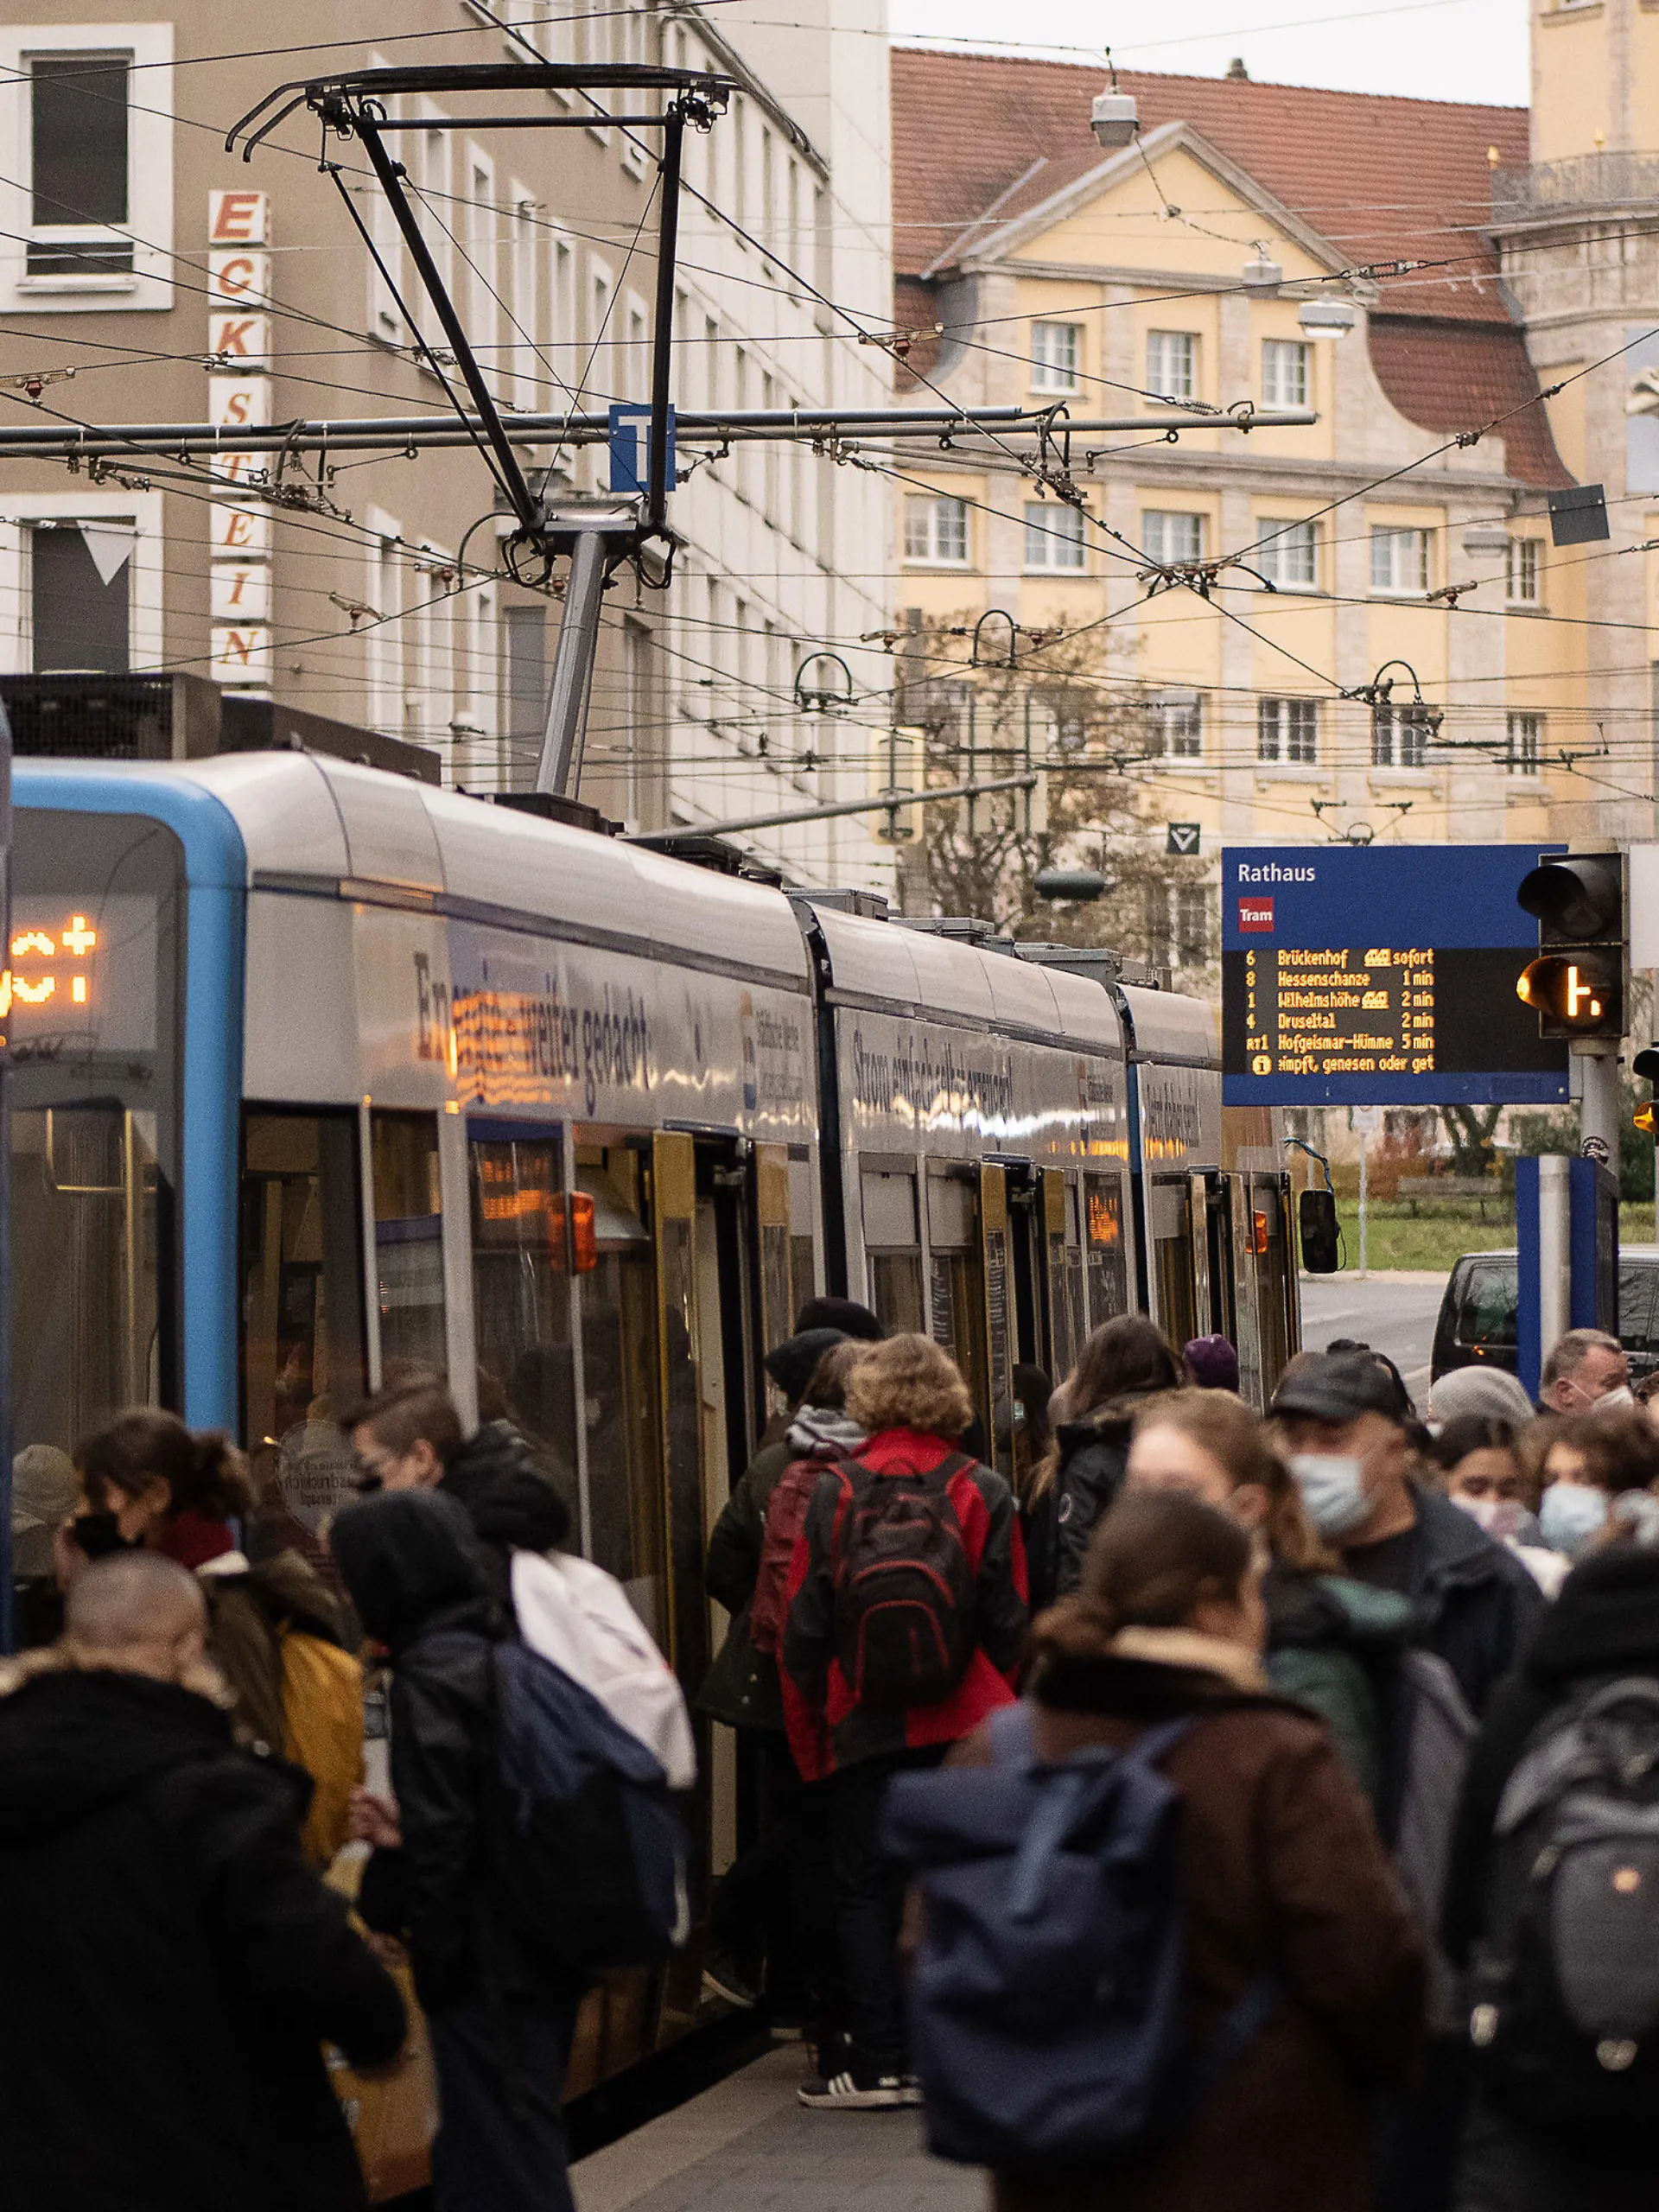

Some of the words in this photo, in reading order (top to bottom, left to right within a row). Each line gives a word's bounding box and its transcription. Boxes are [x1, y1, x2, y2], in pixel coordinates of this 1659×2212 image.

[213, 192, 261, 665] ECKSTEIN
[619, 416, 652, 483] T
[1238, 862, 1315, 882] Rathaus
[1240, 908, 1273, 922] Tram
[1246, 949, 1255, 966] 6
[1278, 949, 1349, 969] Brückenhof
[1393, 948, 1434, 969] sofort
[1246, 970, 1255, 987] 8
[1278, 970, 1371, 987] Hessenschanze
[1402, 969, 1410, 987] 1
[1413, 969, 1434, 987] min
[1248, 992, 1255, 1008] 1
[1278, 991, 1361, 1008] Wilhelmshöhe
[1401, 991, 1411, 1007] 2
[1413, 991, 1434, 1007] min
[1246, 1013, 1255, 1029] 4
[1278, 1012, 1337, 1029] Druseltal
[1401, 1012, 1411, 1028] 2
[1413, 1012, 1434, 1028] min
[1278, 1033, 1394, 1054] Hofgeismar-Hümme
[1401, 1033, 1411, 1050] 5
[1413, 1033, 1434, 1050] min
[1323, 1057, 1375, 1074] genesen
[1379, 1054, 1408, 1071] oder
[1412, 1054, 1434, 1074] get
